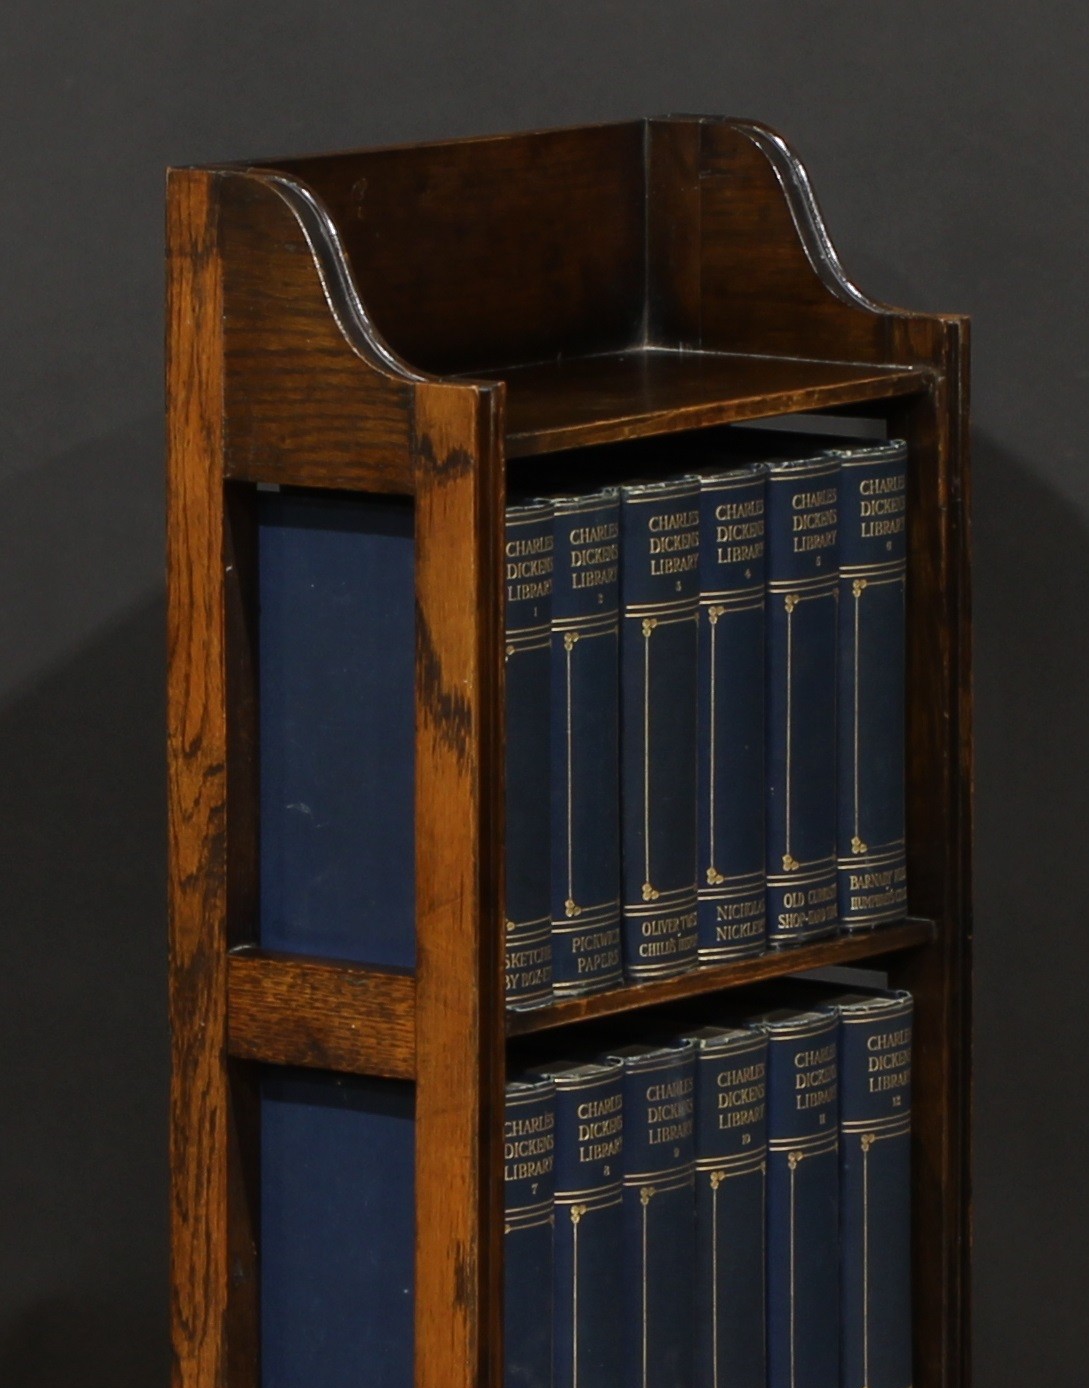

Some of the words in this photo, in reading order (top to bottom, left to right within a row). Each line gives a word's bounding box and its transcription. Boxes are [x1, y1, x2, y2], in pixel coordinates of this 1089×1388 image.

[792, 488, 837, 510] CHARLES
[649, 511, 699, 531] CHARLES
[793, 509, 837, 531] DICKENS
[650, 532, 699, 554] DICKENS
[651, 553, 699, 575] LIBRARY
[533, 607, 538, 617] 1
[783, 892, 805, 908] OLD
[642, 919, 680, 936] OLIVER
[531, 1183, 538, 1194] 7
